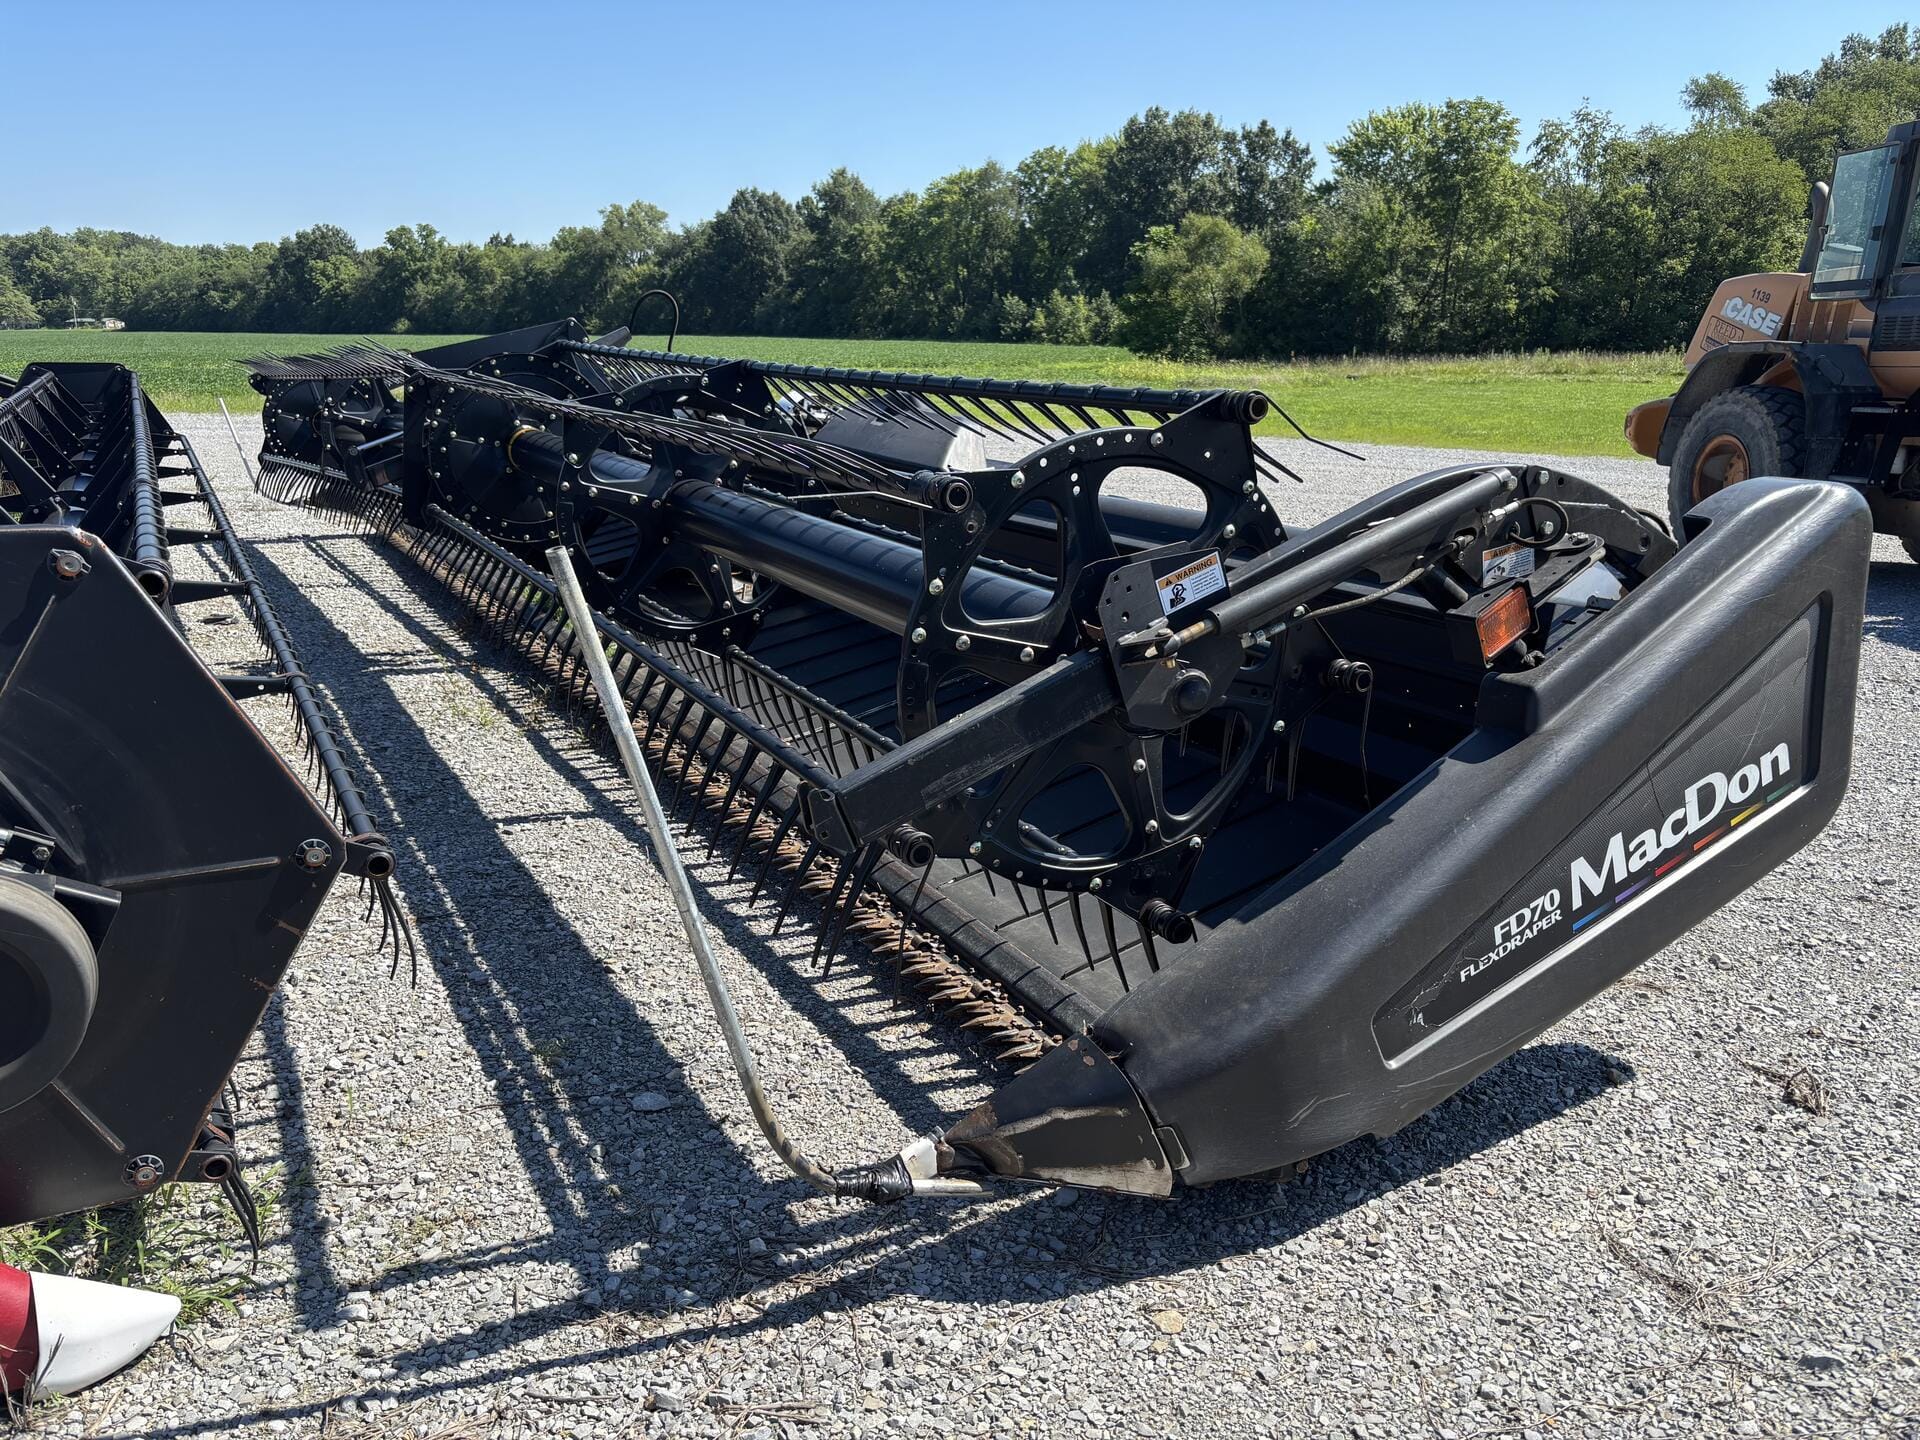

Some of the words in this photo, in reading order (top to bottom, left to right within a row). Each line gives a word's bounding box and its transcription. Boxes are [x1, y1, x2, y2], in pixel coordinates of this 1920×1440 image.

[1726, 296, 1781, 336] CASE
[1752, 288, 1771, 303] 1139
[1175, 558, 1212, 580] WARNING
[1571, 742, 1791, 911] MacDon
[1494, 888, 1561, 946] FD70
[1460, 910, 1563, 983] FLEXDRAPER
